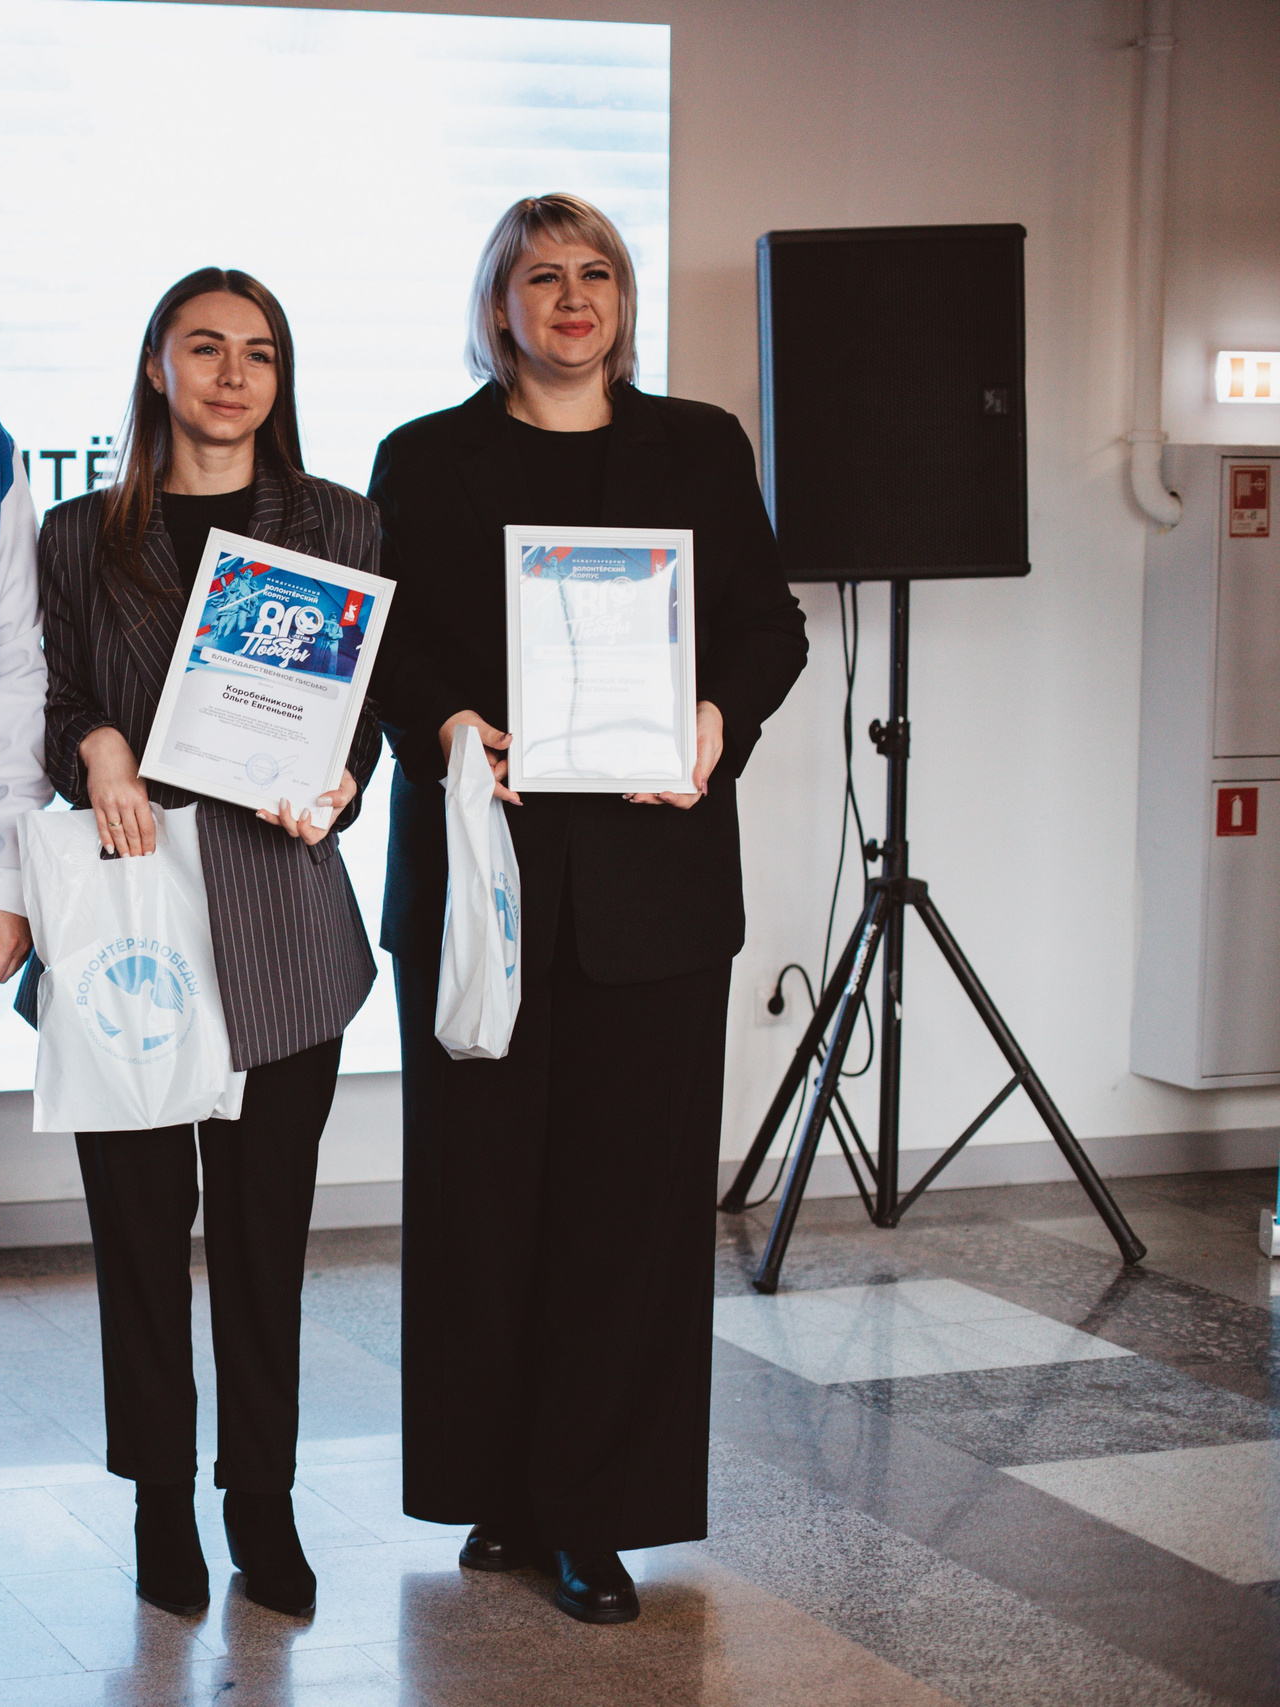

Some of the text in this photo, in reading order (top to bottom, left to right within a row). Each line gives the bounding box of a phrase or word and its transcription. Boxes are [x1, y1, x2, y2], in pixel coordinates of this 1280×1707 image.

[265, 583, 319, 605] ВОЛОНТЁРСКИЙ
[211, 653, 328, 692] БЛАГОДАРСТВЕННОЕ ПИСЬМО
[222, 692, 303, 721] Ольге Евгеньевне
[225, 684, 304, 713] Коробейниковой
[76, 937, 200, 1006] ВОЛОНТЁРЫ ПОБЕДЫ
